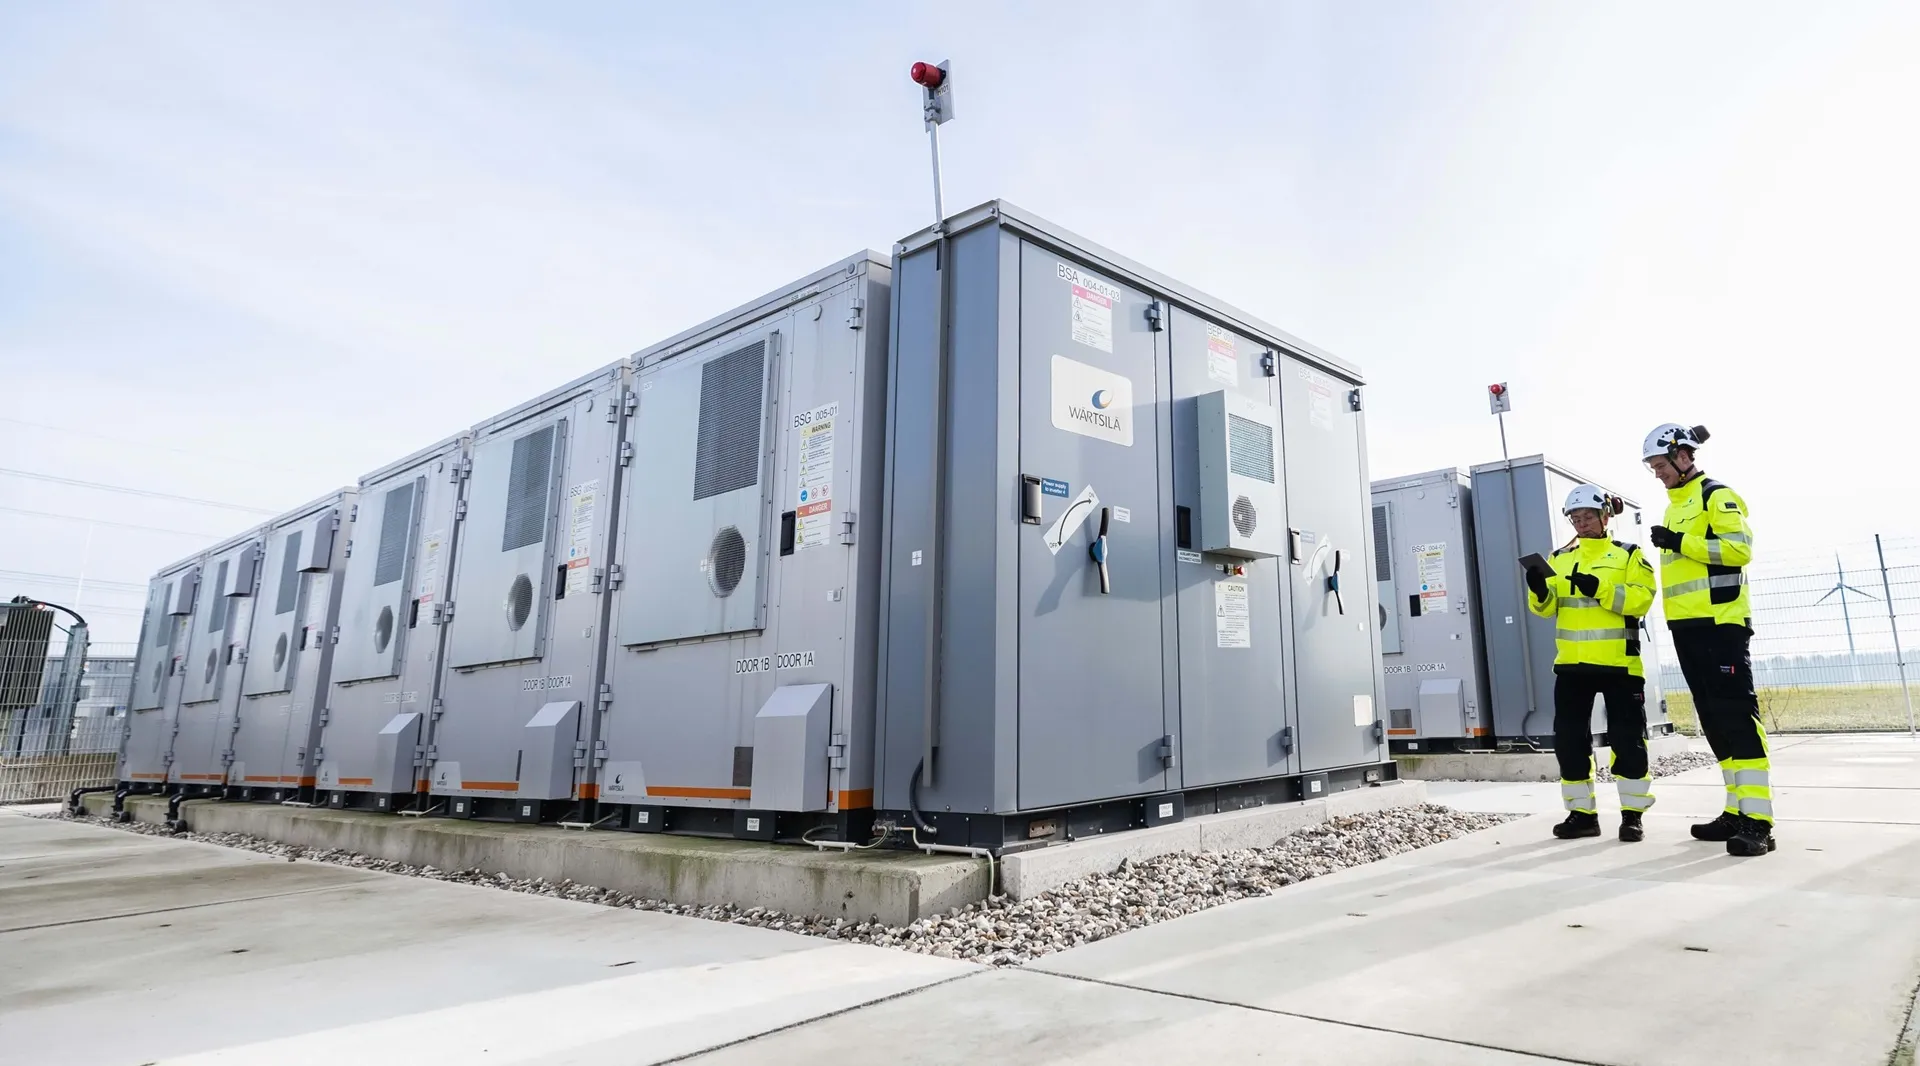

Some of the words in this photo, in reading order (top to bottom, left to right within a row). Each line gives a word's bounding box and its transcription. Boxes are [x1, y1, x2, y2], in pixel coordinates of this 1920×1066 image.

[1058, 263, 1079, 284] BSA
[1082, 278, 1120, 300] 004-01-03
[794, 411, 811, 428] BSG
[815, 405, 837, 421] 005-01
[1068, 405, 1121, 431] WÄRTSILÄ
[811, 421, 831, 433] WARNING
[1055, 482, 1067, 490] supply
[808, 502, 828, 514] DANGER
[1411, 544, 1426, 554] BSG
[1227, 584, 1245, 592] CAUTION
[736, 658, 758, 673] DOOR
[760, 657, 770, 671] 1B
[777, 653, 801, 669] DOOR
[803, 652, 814, 666] 1A
[1384, 665, 1402, 674] DOOR
[1403, 665, 1411, 673] 1B
[1417, 663, 1436, 672] DOOR
